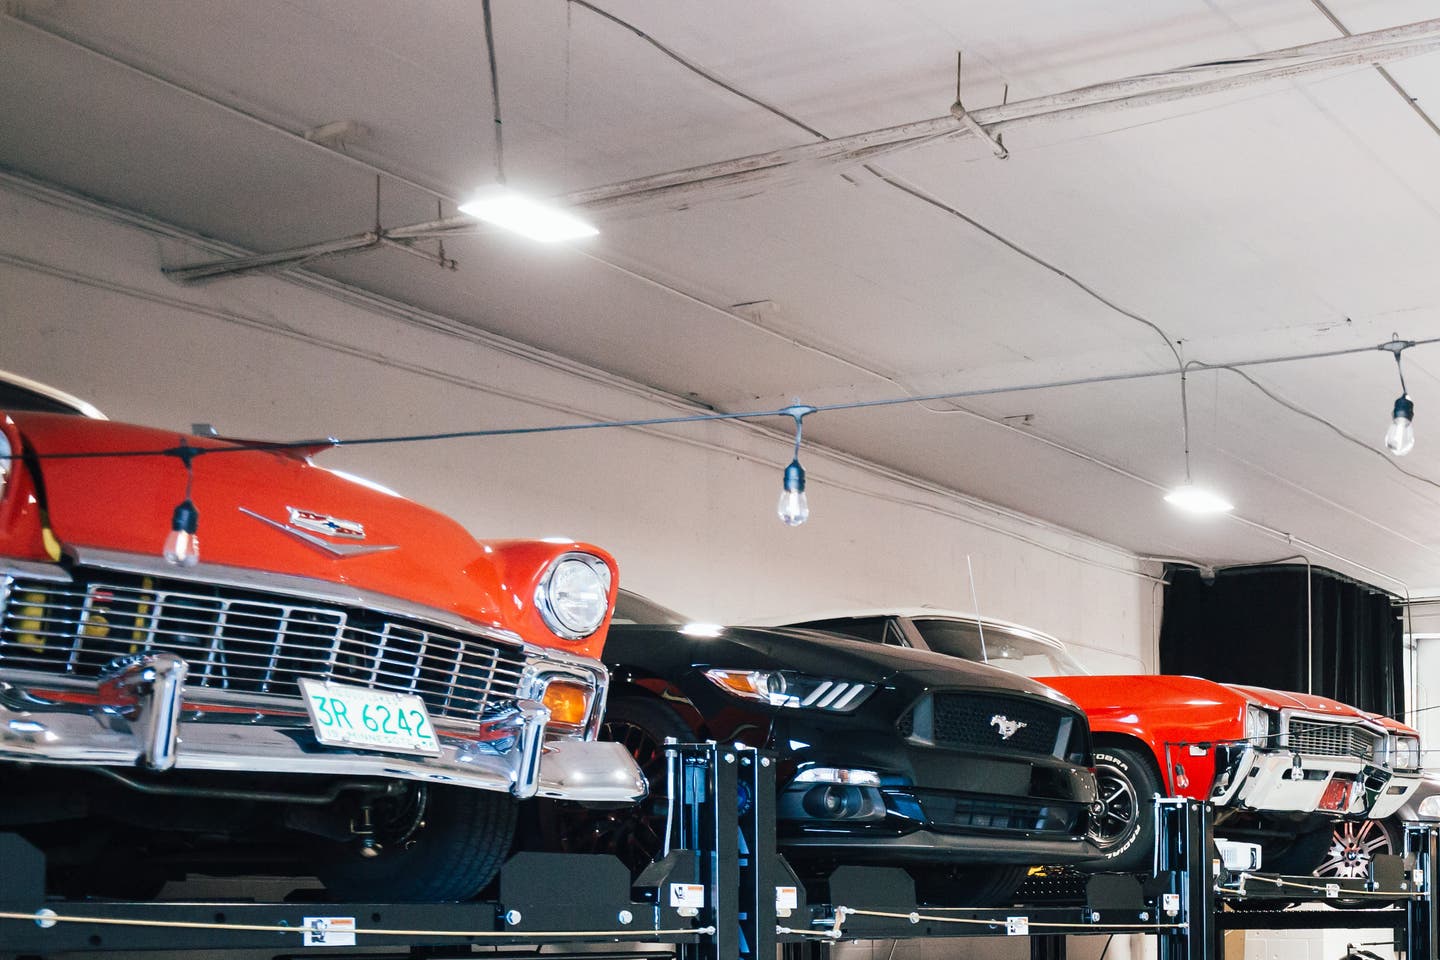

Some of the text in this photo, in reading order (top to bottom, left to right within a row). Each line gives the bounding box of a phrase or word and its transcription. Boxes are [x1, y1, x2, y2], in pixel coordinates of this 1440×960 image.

[311, 695, 353, 729] 3R
[362, 703, 432, 739] 6242
[1092, 753, 1128, 771] OBRA
[1105, 824, 1141, 860] RADIAL
